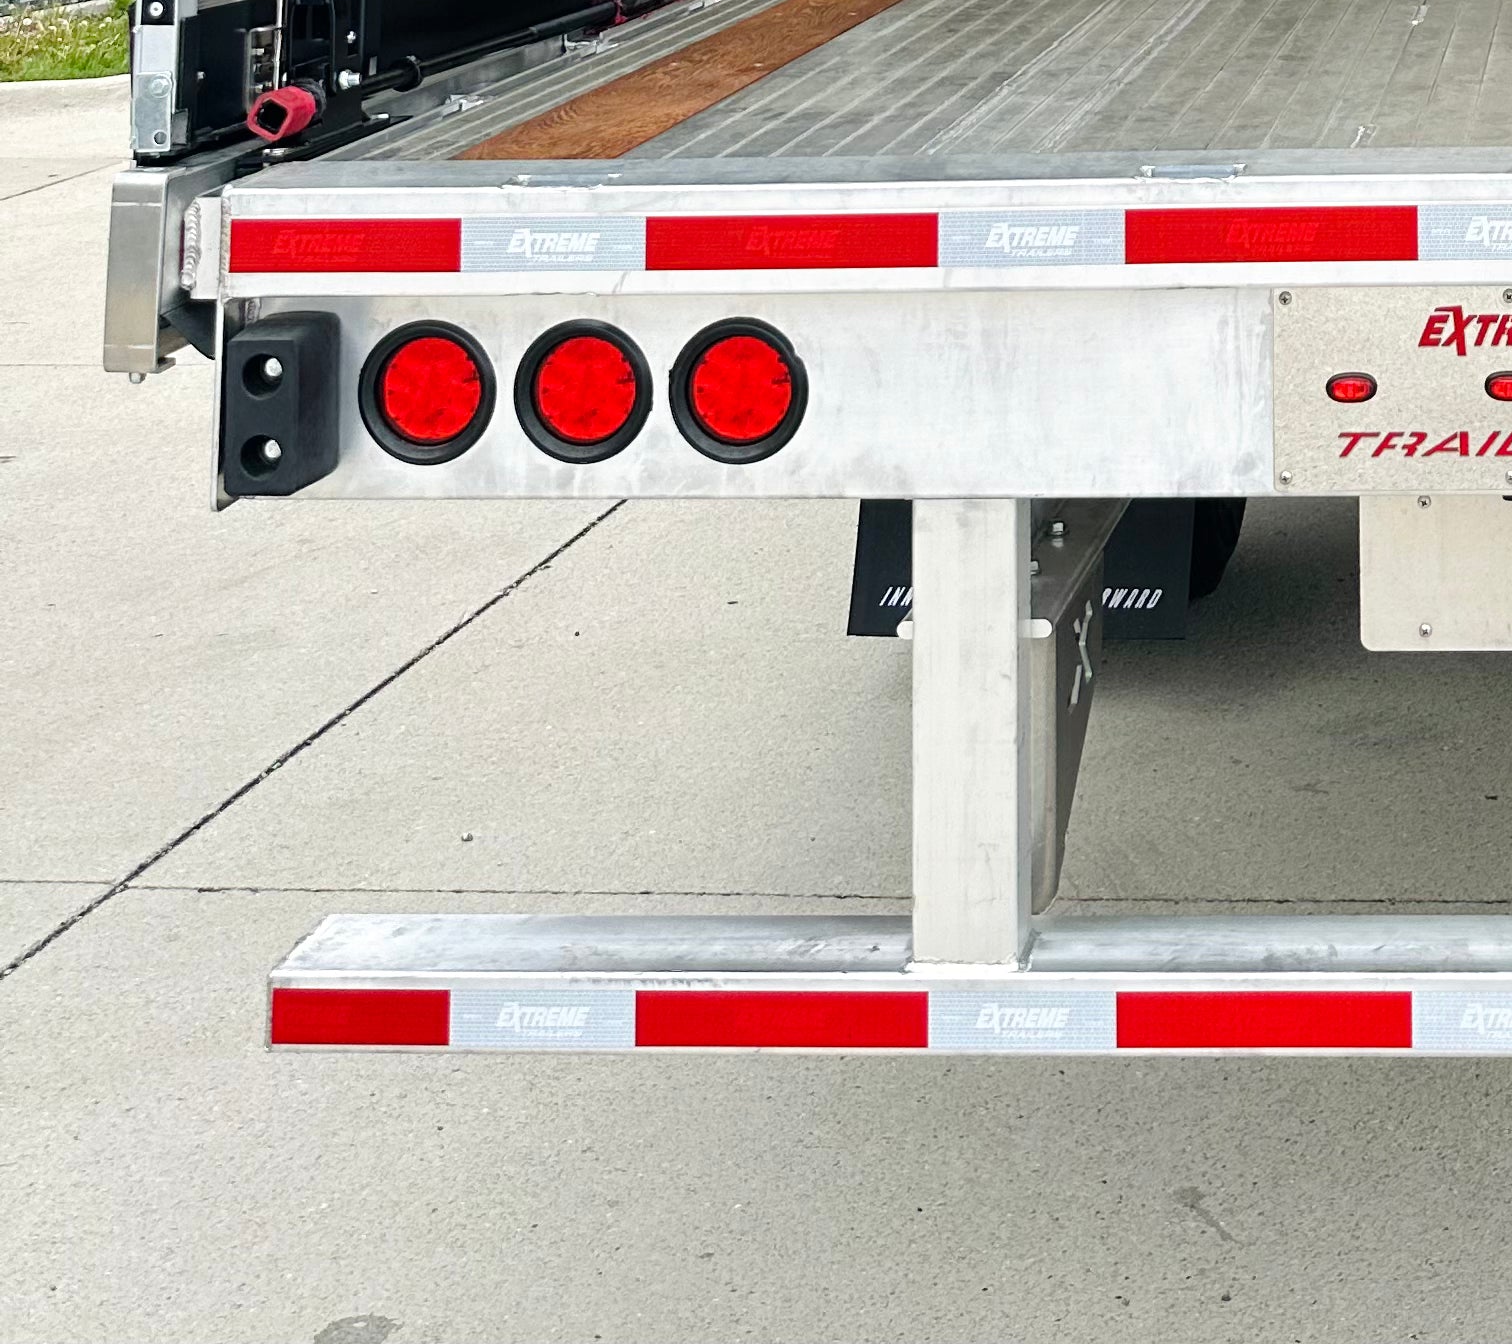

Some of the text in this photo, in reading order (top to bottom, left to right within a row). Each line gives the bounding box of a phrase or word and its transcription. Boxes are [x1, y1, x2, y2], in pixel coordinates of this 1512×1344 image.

[506, 228, 601, 258] EXTREME
[985, 223, 1081, 252] EXTREME
[1102, 587, 1163, 609] RWARD
[496, 1002, 590, 1032] EXTREME
[975, 1003, 1070, 1033] EXTREME
